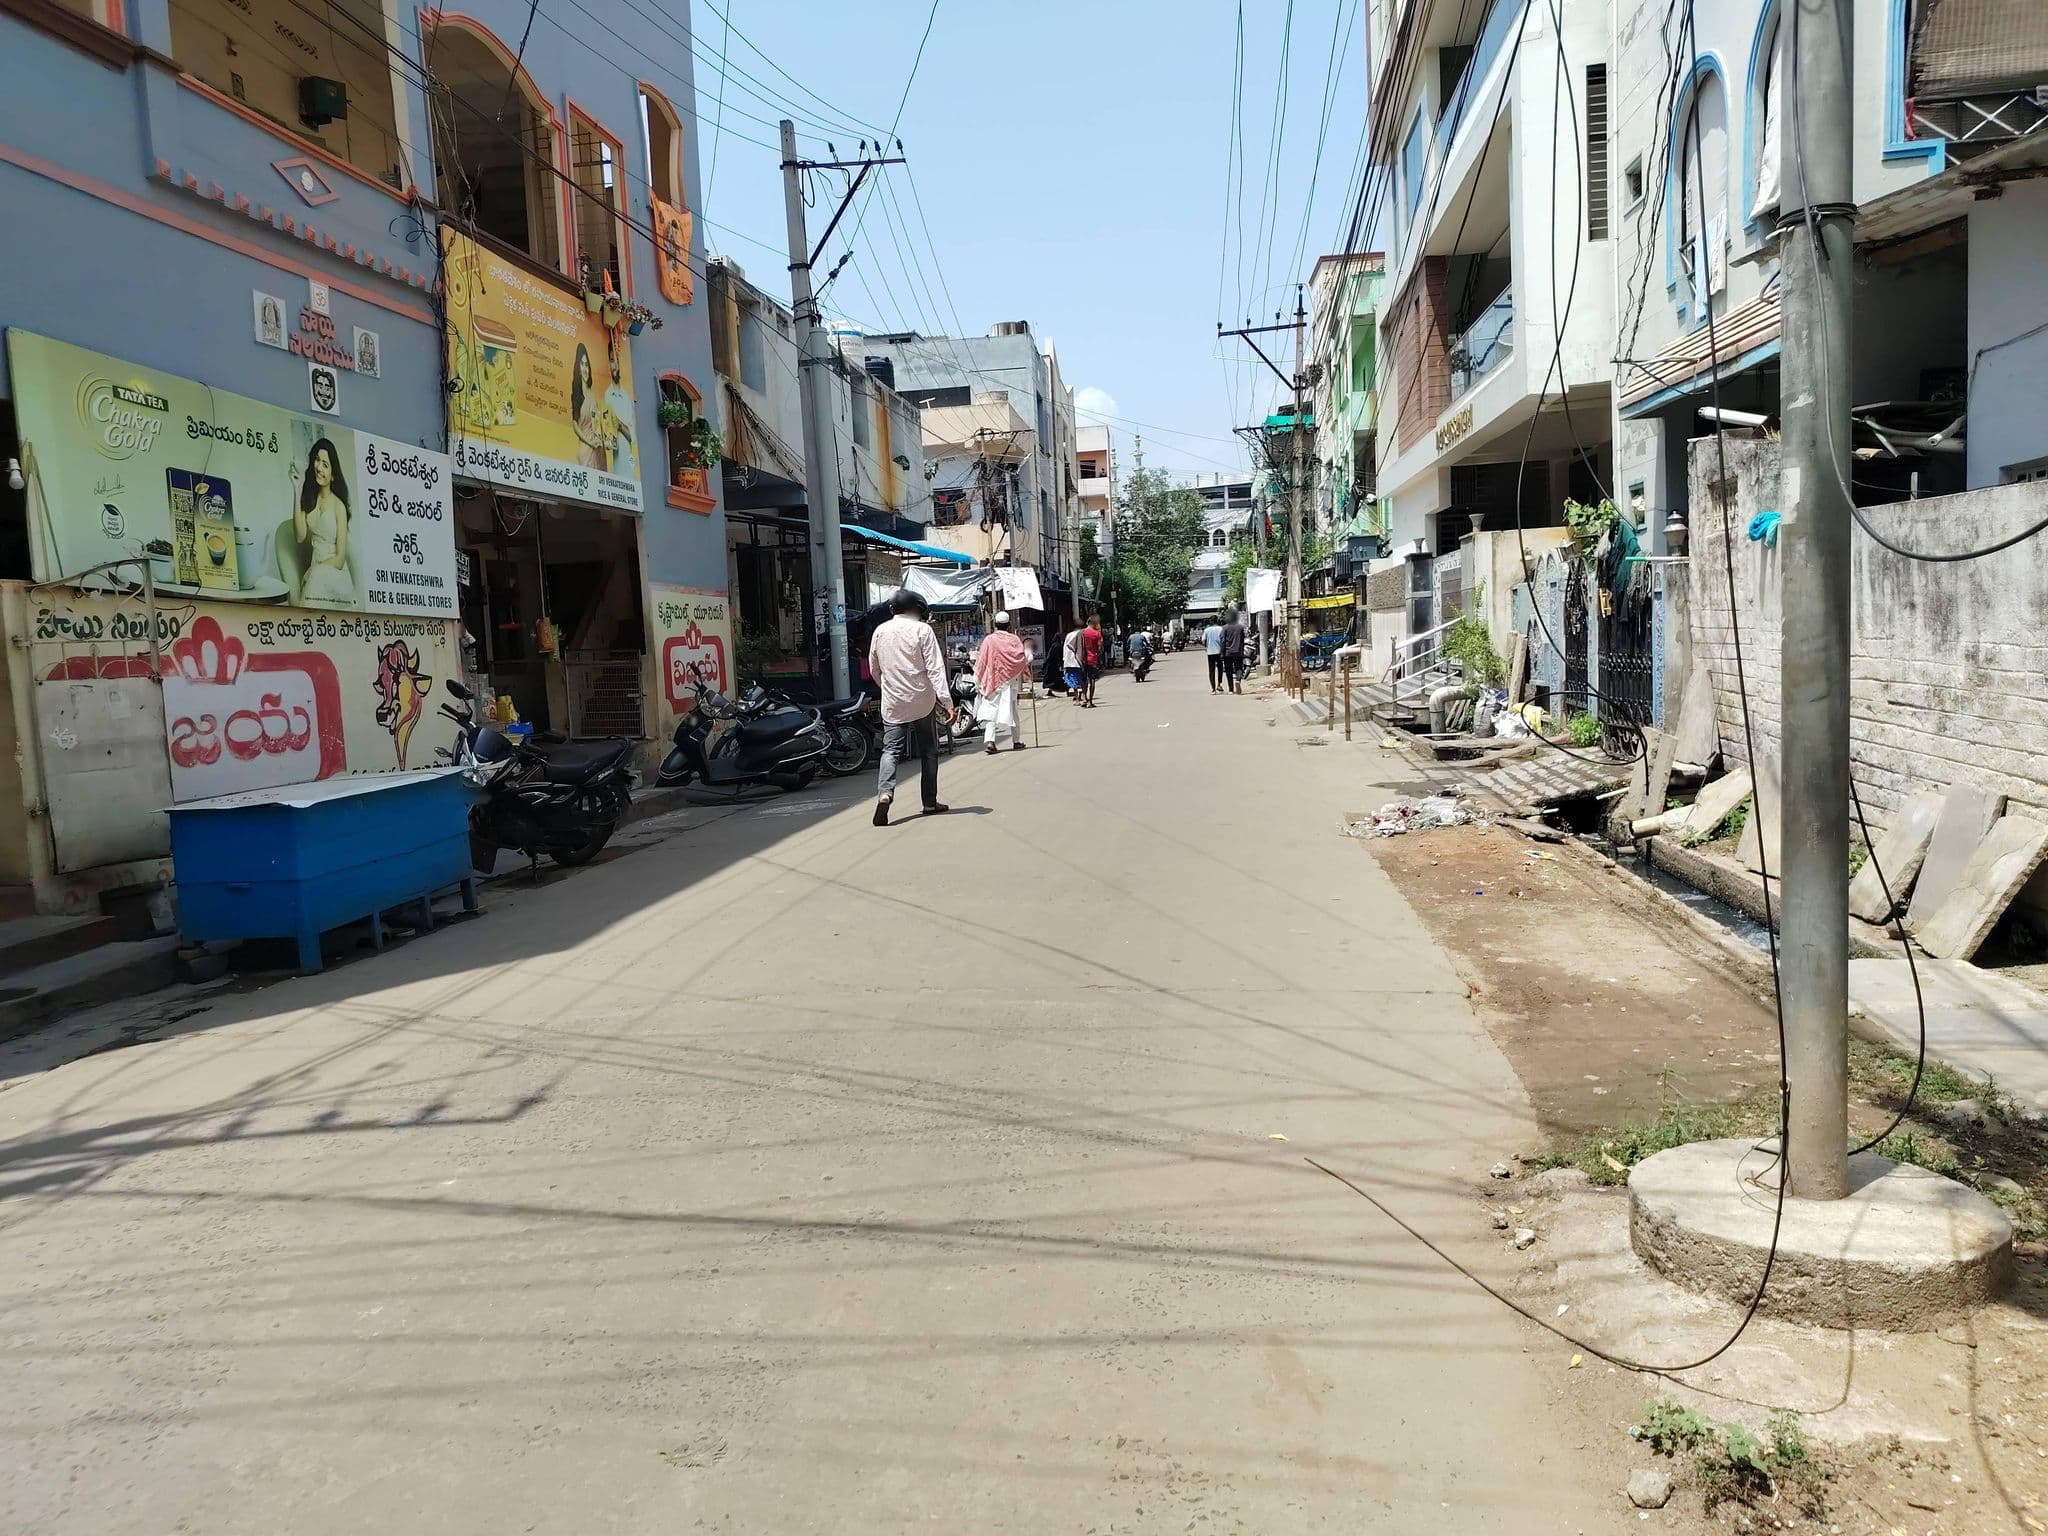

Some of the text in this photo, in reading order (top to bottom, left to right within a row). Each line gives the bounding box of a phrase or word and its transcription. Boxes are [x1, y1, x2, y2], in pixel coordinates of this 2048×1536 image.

[117, 387, 165, 410] TATA TEA
[92, 394, 163, 436] Chakra
[104, 424, 155, 453] Gold
[365, 443, 439, 490] శ్రీ వెంకటేశ్వర
[456, 440, 466, 468] శ్రీ
[469, 446, 516, 480] వెంకటేశ్వర
[517, 458, 532, 483] రైస్
[534, 463, 543, 480] &
[545, 468, 571, 486] జనరల్
[367, 488, 443, 522] రైస్ & జనరల్
[376, 569, 389, 583] SRI
[389, 571, 444, 589] VENKATESHWRA
[368, 590, 387, 604] RICE
[388, 592, 394, 604] &
[395, 592, 427, 607] GENERAL
[427, 595, 453, 609] STORES
[315, 615, 336, 637] వేల
